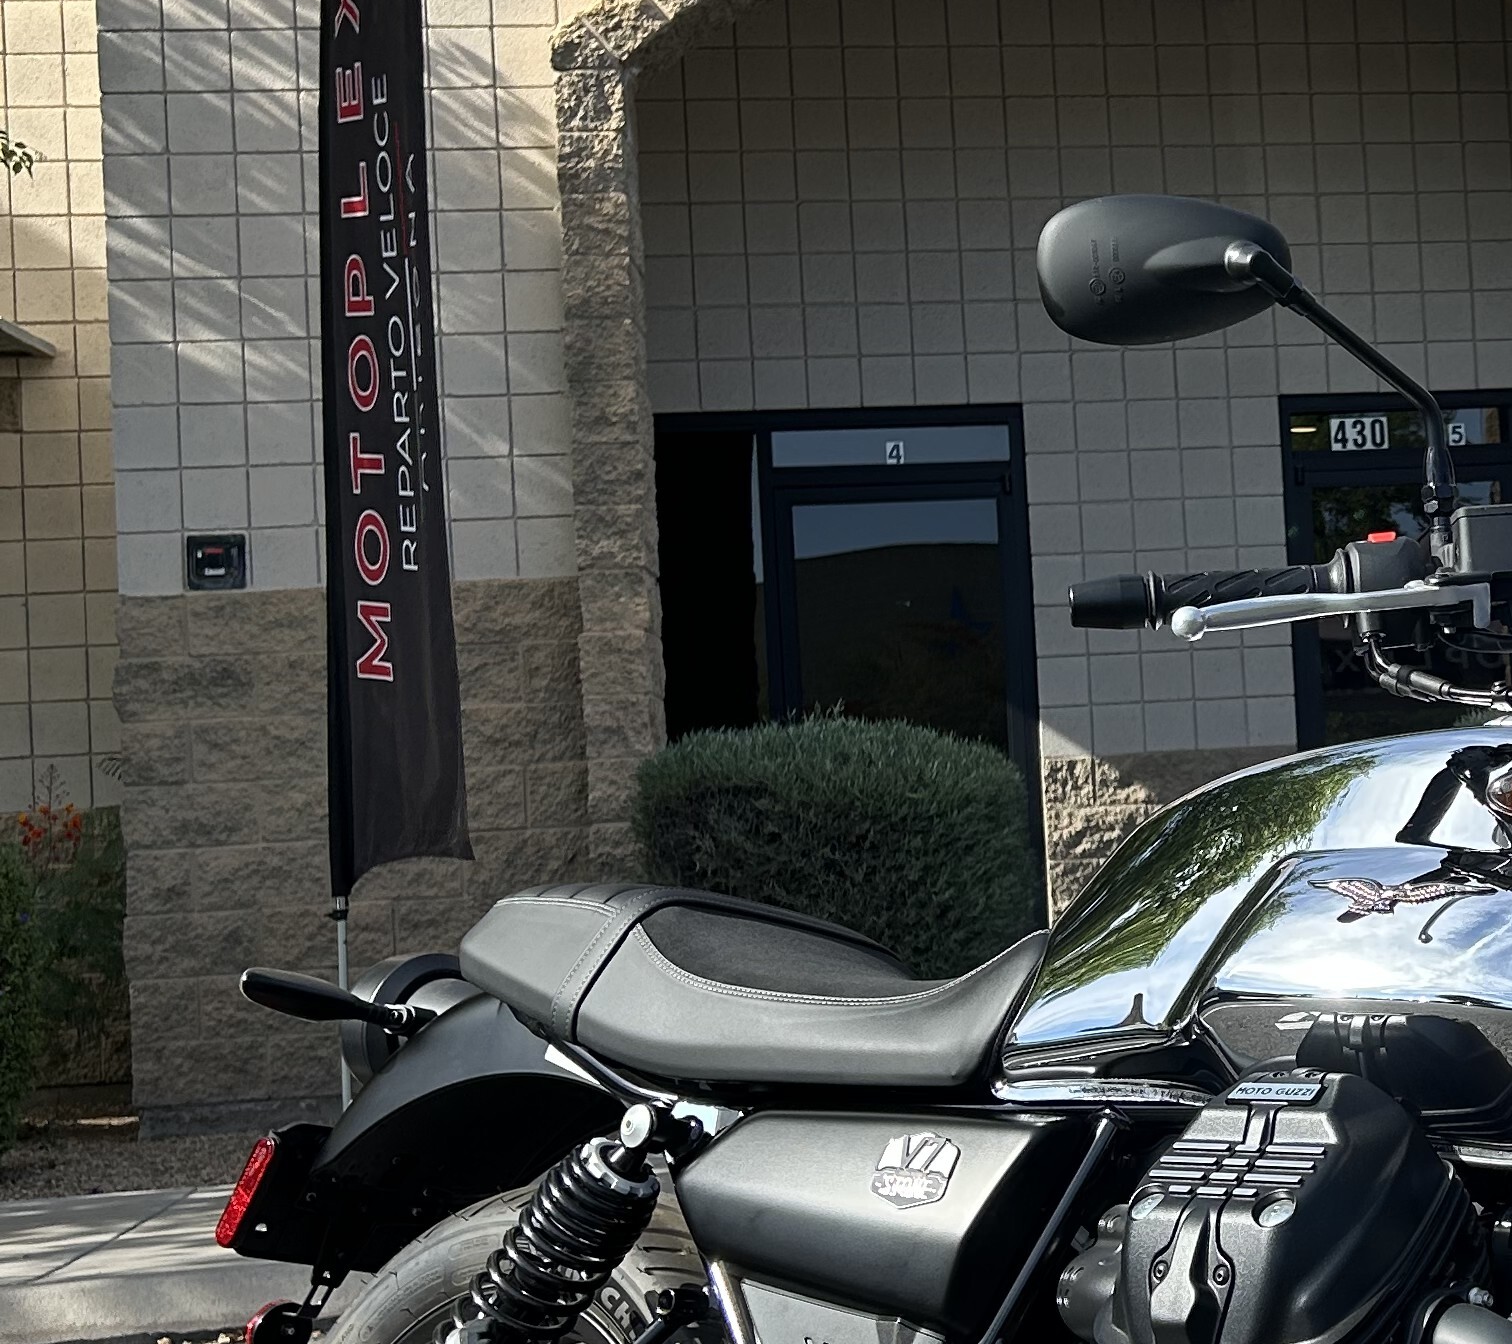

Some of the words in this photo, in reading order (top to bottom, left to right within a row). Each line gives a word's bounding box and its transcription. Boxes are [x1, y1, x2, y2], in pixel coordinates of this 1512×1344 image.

[371, 73, 401, 300] VELOCE
[387, 315, 419, 571] REPARTO
[1332, 418, 1388, 450] 430
[1450, 425, 1463, 445] 5
[888, 443, 903, 465] 4
[1237, 1085, 1272, 1100] MOTO
[1274, 1084, 1317, 1099] GUZZI
